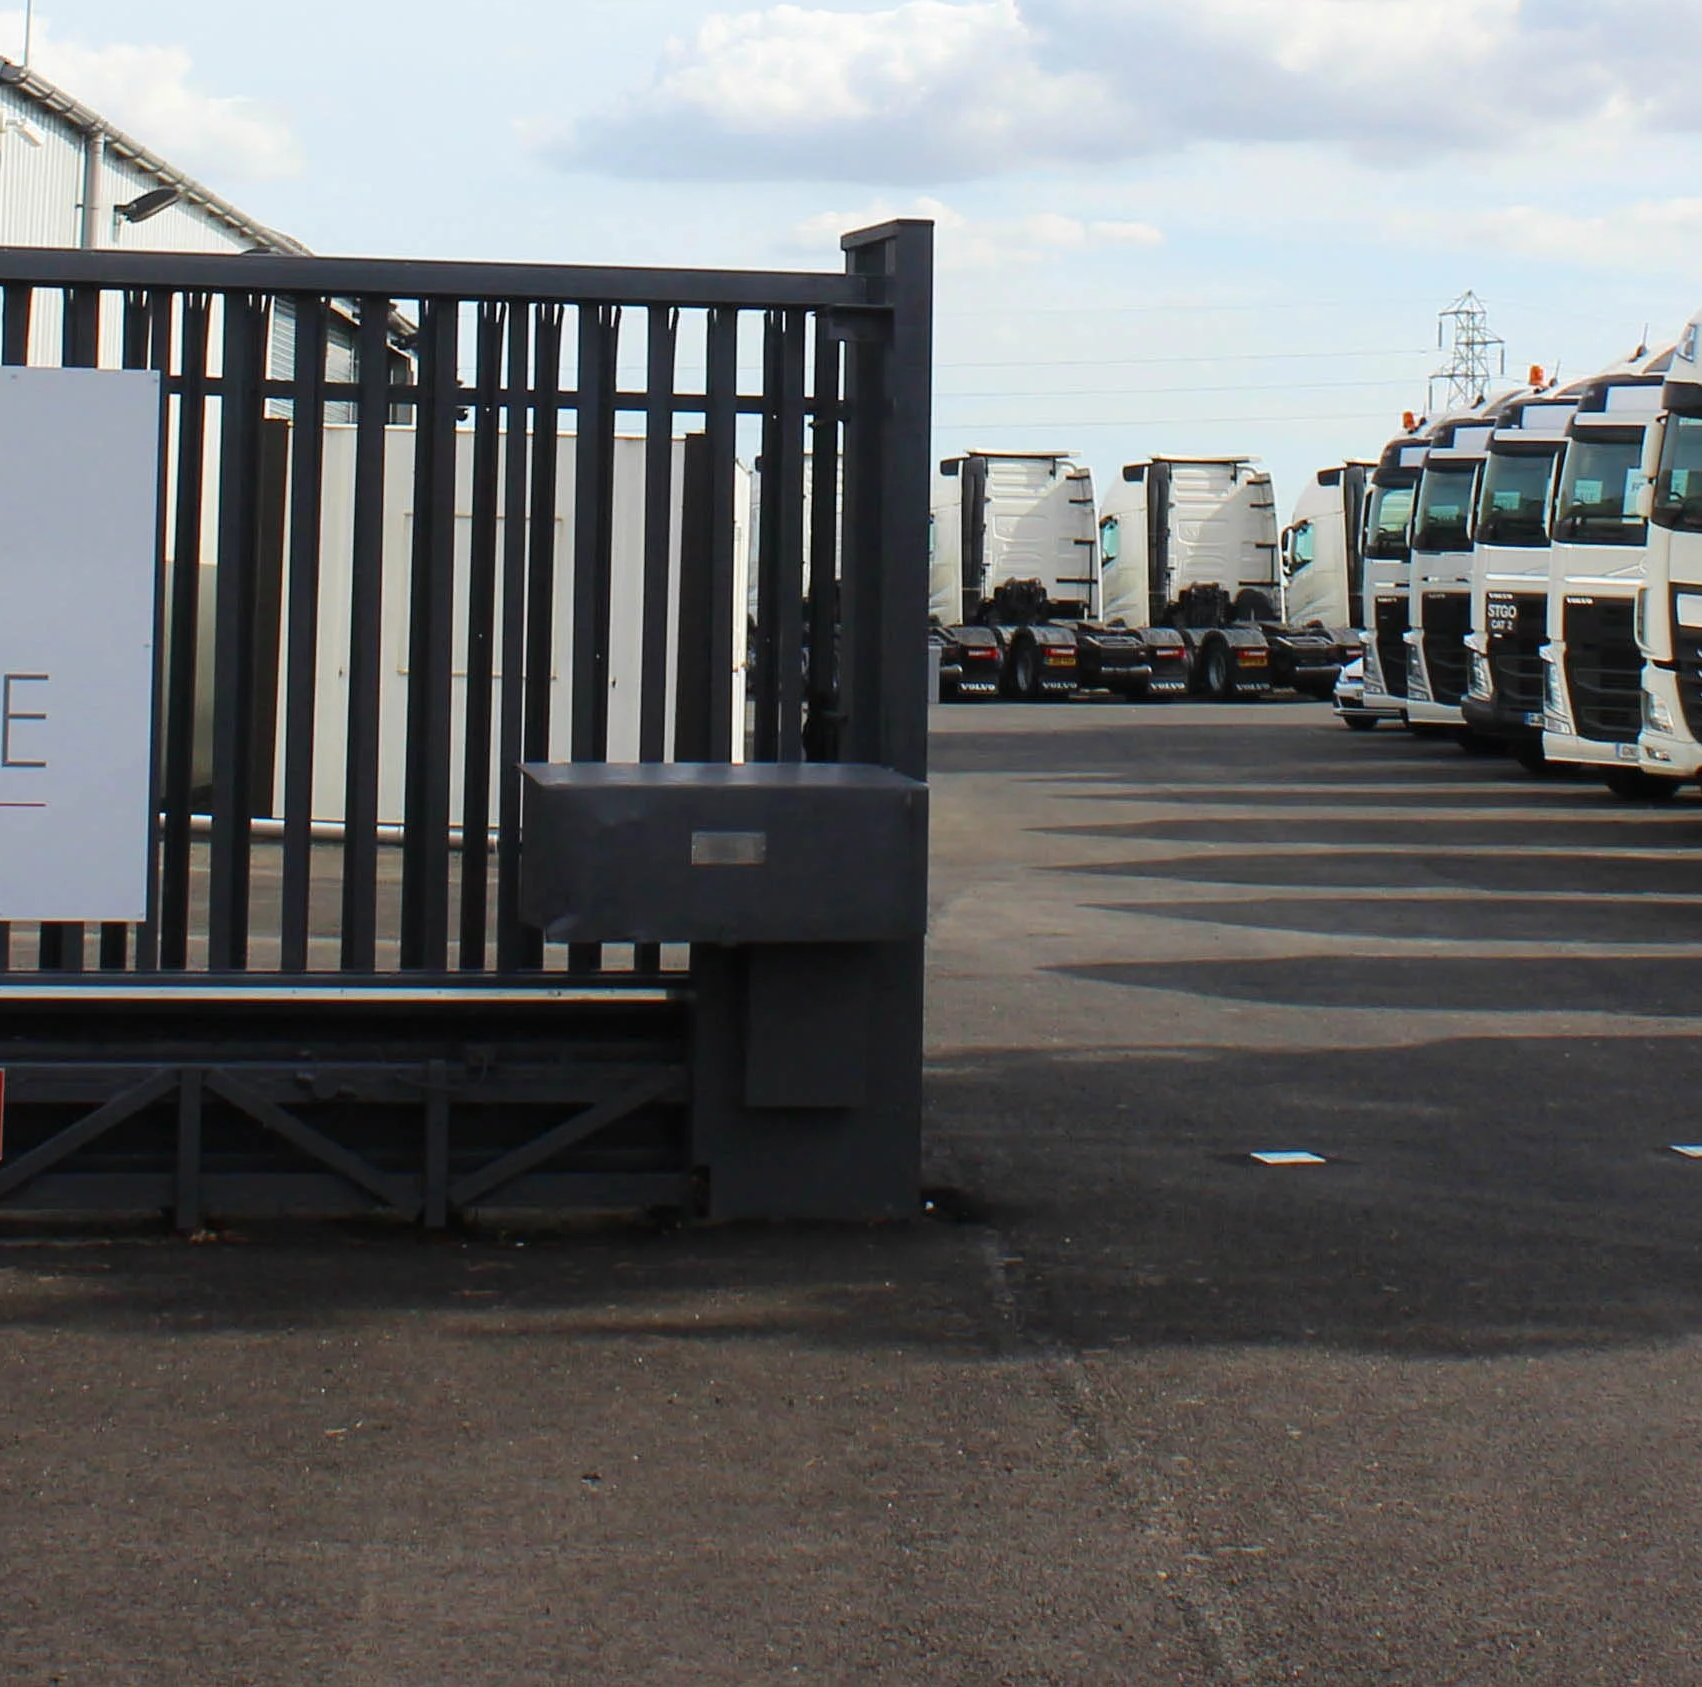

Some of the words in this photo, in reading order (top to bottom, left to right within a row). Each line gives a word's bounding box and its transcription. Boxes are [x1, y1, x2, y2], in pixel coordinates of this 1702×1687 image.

[1487, 603, 1517, 619] STGO
[1491, 619, 1506, 630] CAT
[960, 682, 996, 691] VOLVO
[1042, 681, 1078, 690] VOLVO
[1150, 682, 1186, 691] VOLVO
[1235, 683, 1271, 691] VOLVO
